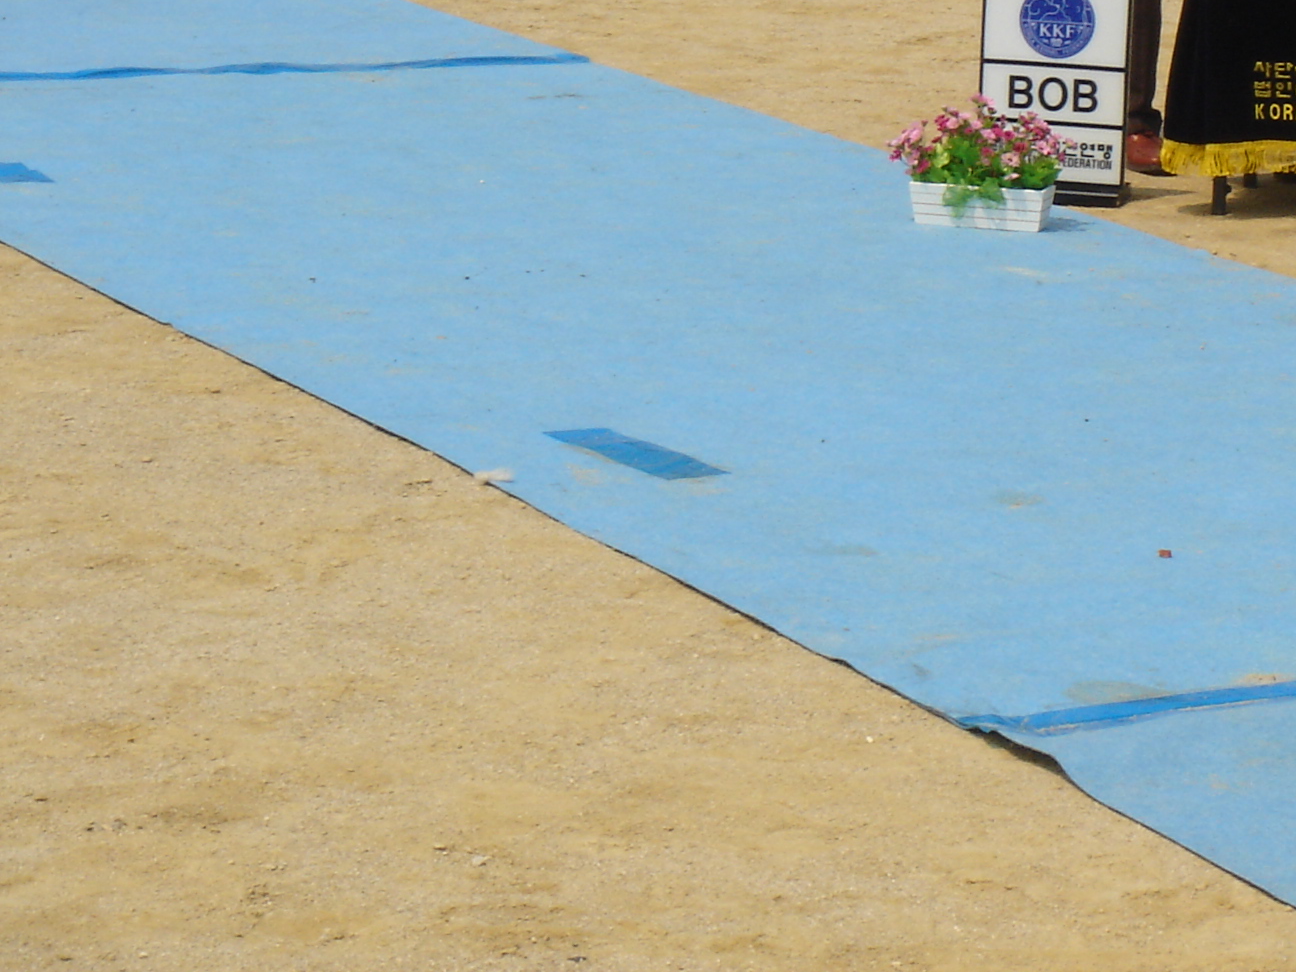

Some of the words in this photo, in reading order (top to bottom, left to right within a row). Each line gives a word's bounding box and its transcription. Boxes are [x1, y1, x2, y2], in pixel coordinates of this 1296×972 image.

[1038, 22, 1075, 39] KKF
[1253, 61, 1293, 79] 사단
[1008, 75, 1098, 113] BOB
